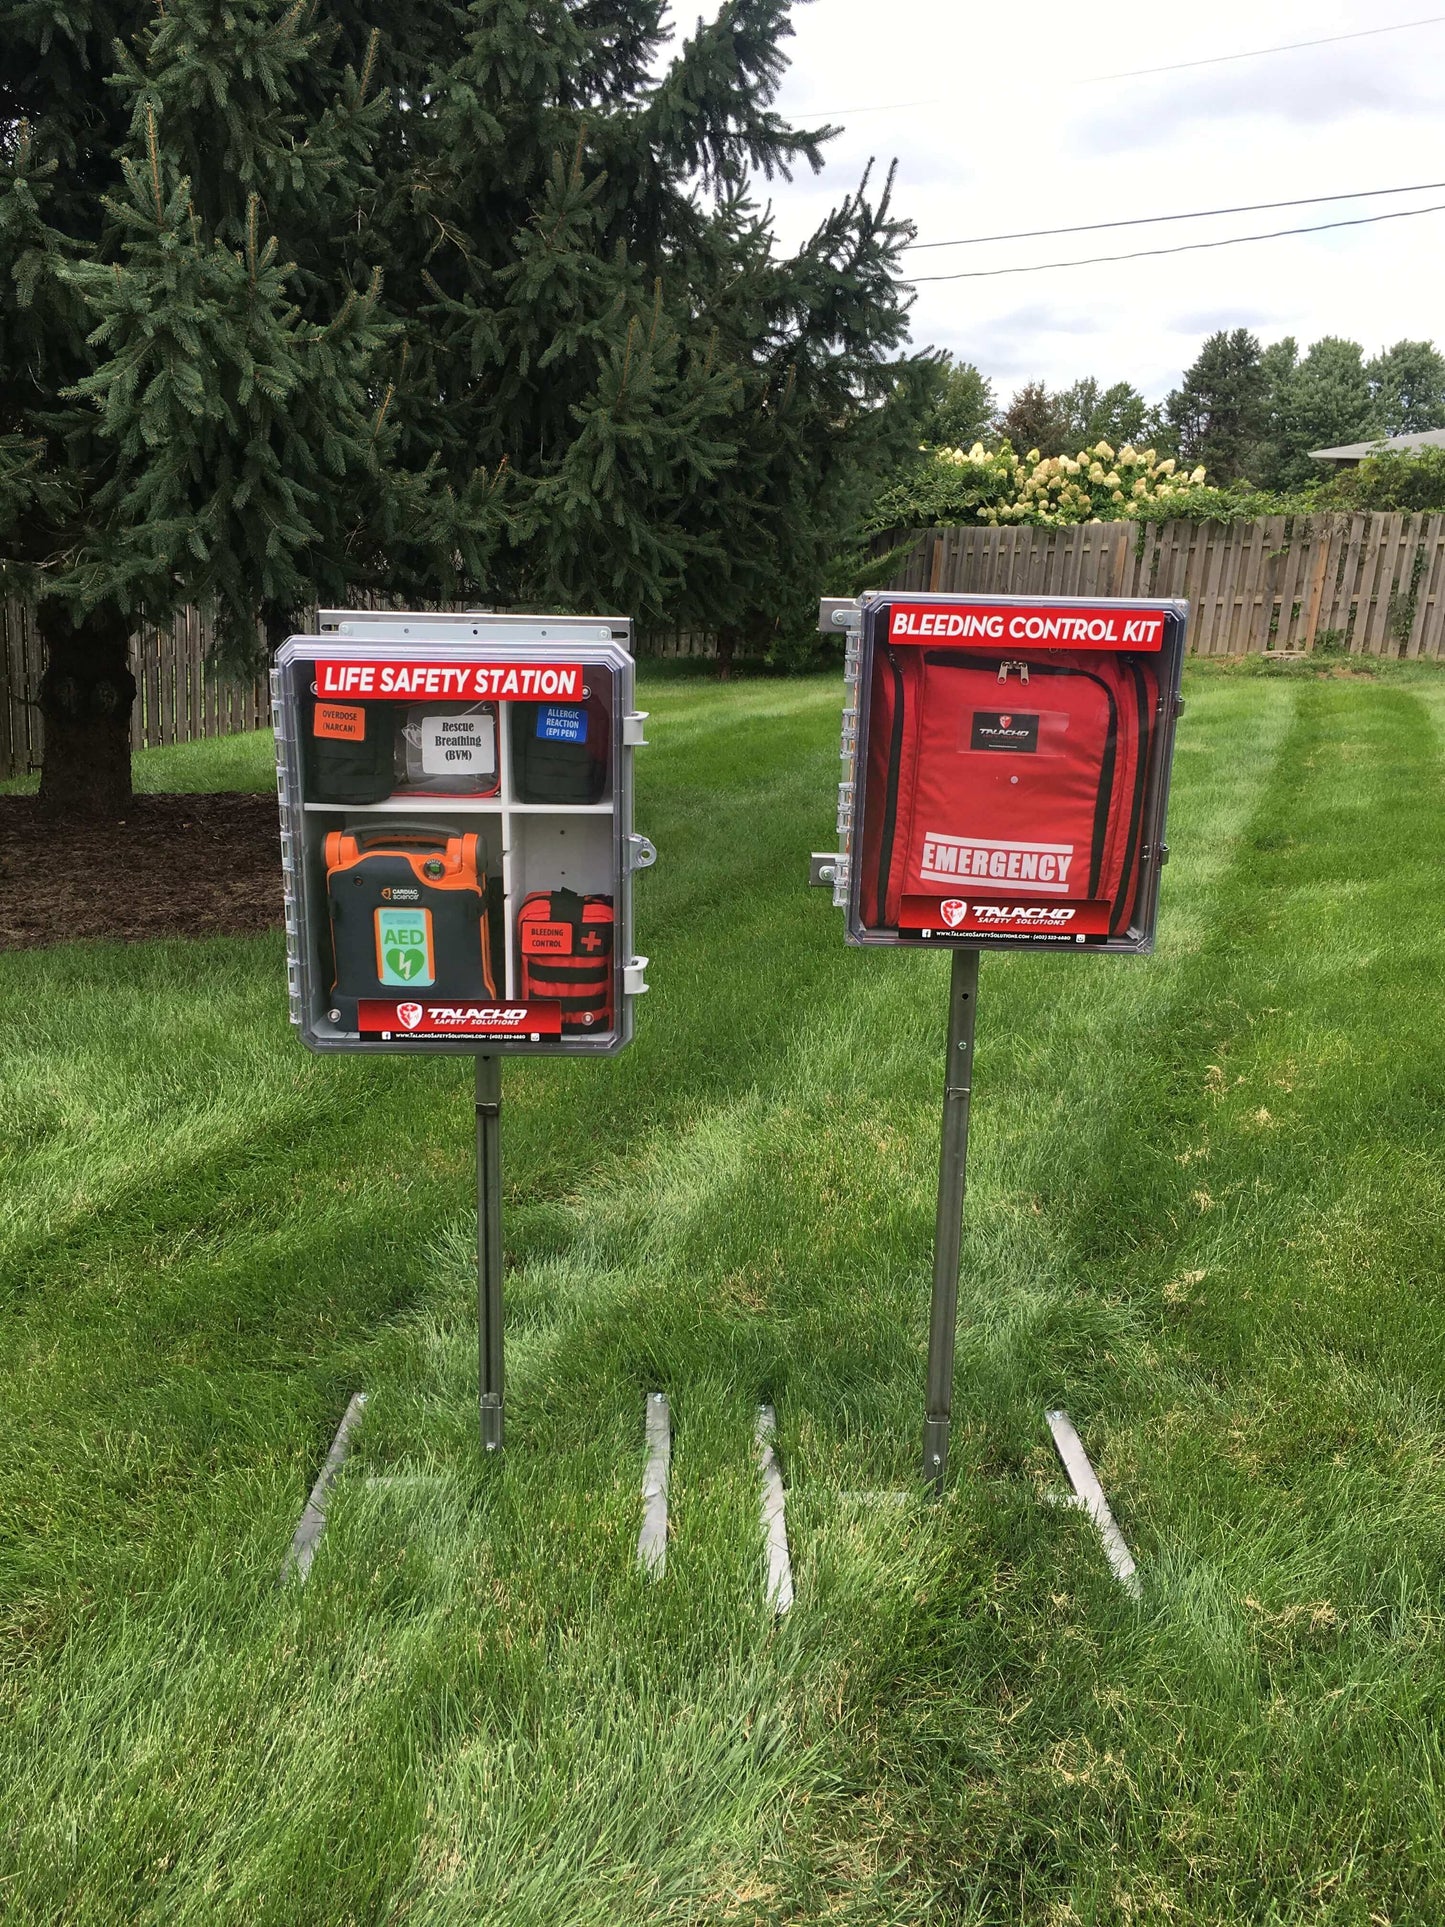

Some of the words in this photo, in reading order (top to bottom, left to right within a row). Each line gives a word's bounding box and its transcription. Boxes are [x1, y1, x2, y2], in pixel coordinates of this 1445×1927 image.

[892, 613, 1004, 638] BLEEDING
[1008, 617, 1117, 641] CONTROL
[1122, 620, 1161, 643] KIT
[324, 667, 375, 692] LIFE
[379, 667, 471, 693] SAFETY
[474, 668, 577, 695] STATION
[322, 710, 358, 721] OVERDOSE
[547, 708, 580, 719] ALLERGIC
[322, 722, 356, 733] (NARCAN)
[442, 721, 475, 732] Rescue
[546, 718, 579, 729] REACTION
[546, 729, 560, 738] (EPI
[560, 730, 577, 739] PEN)
[435, 735, 482, 748] Breathing
[445, 749, 472, 761] (BVM)
[921, 842, 1073, 882] EMERGENCY
[1015, 918, 1067, 926] SOLUTIONS
[384, 929, 425, 945] AED
[531, 928, 564, 937] BLEEDING
[532, 939, 562, 948] CONTROL
